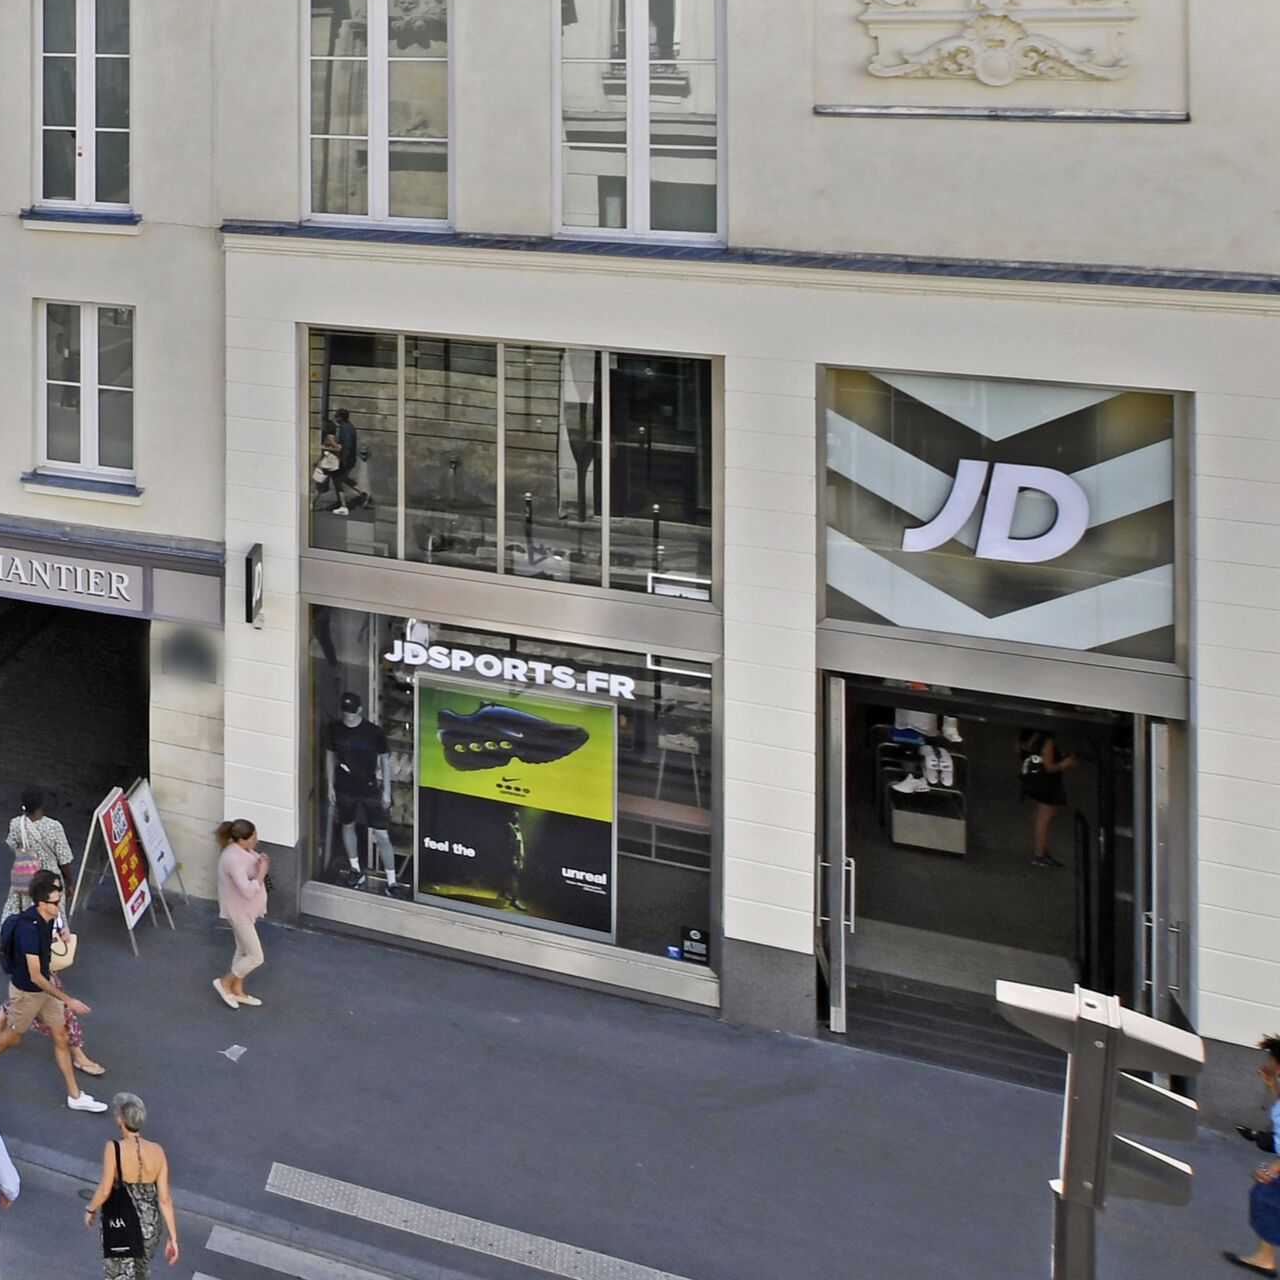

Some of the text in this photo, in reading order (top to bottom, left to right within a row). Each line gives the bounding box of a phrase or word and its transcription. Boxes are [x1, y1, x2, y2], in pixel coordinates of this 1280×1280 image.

[902, 459, 1089, 563] JD
[384, 640, 636, 700] JDSPORTS.FR
[423, 836, 476, 858] feel the
[561, 867, 607, 885] unreal
